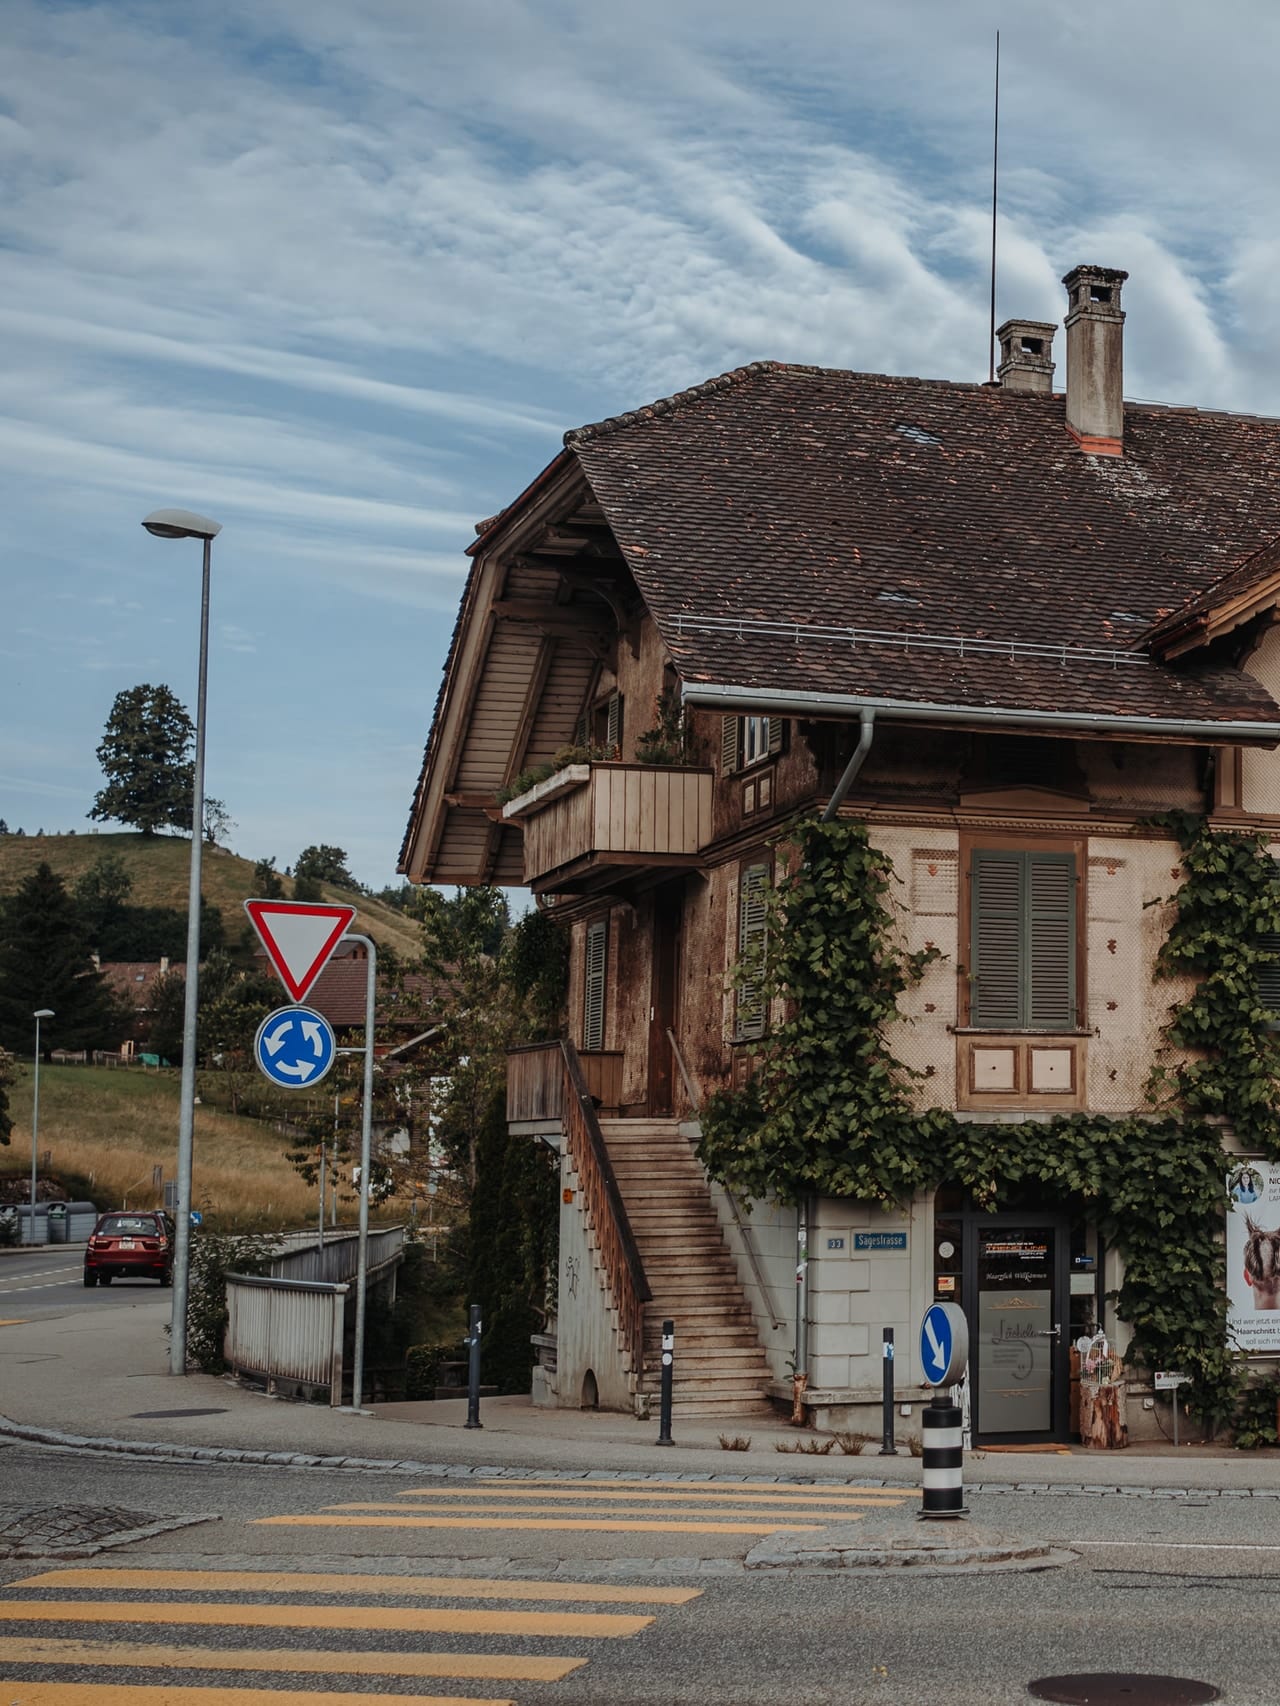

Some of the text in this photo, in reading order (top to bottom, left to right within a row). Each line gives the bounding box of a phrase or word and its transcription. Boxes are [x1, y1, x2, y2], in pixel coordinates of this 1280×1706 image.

[831, 1240, 841, 1248] 33
[1255, 1317, 1270, 1326] jetzt
[1237, 1327, 1276, 1335] Haarschnitt
[1257, 1337, 1271, 1345] sich
